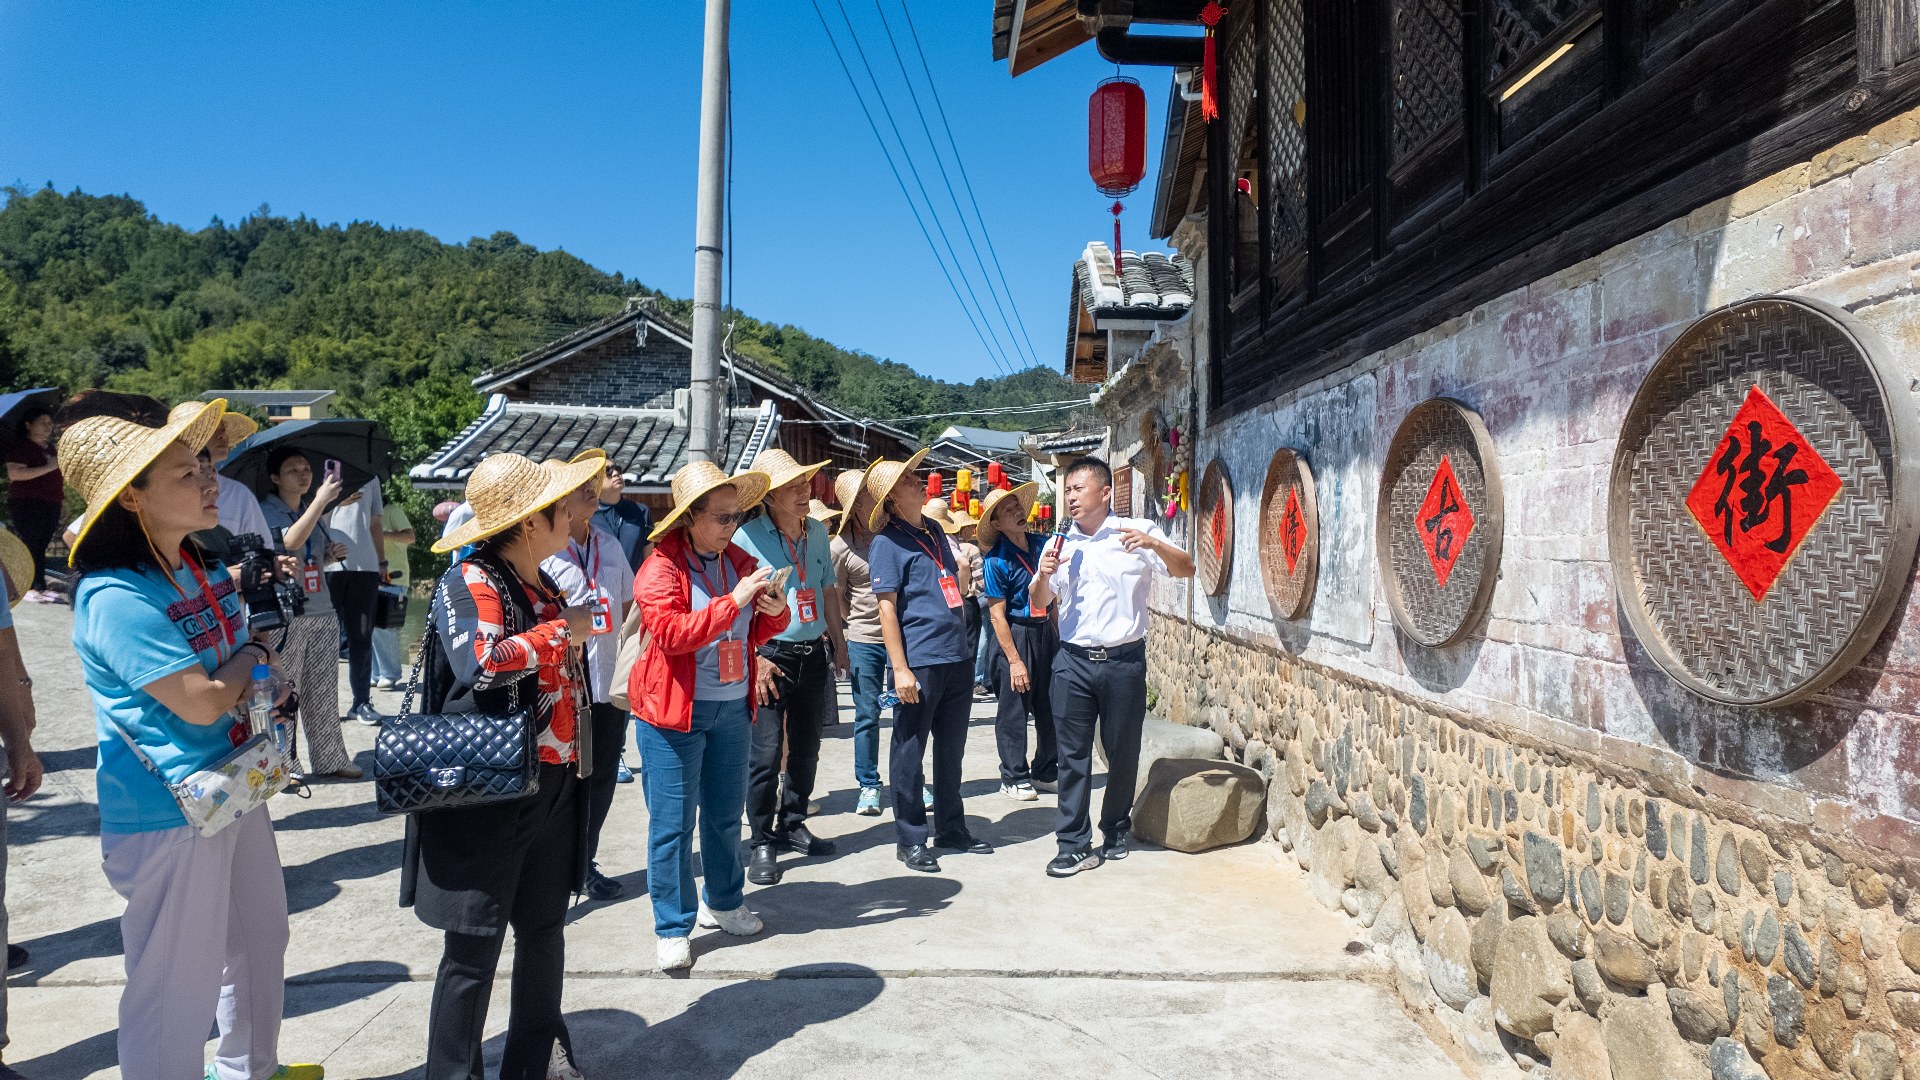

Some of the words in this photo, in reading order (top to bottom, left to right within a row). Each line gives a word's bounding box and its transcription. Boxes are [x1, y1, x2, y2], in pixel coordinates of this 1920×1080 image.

[1286, 499, 1300, 561] 清
[1425, 475, 1460, 561] 古
[1714, 421, 1810, 555] 街
[442, 584, 456, 636] LEATHER
